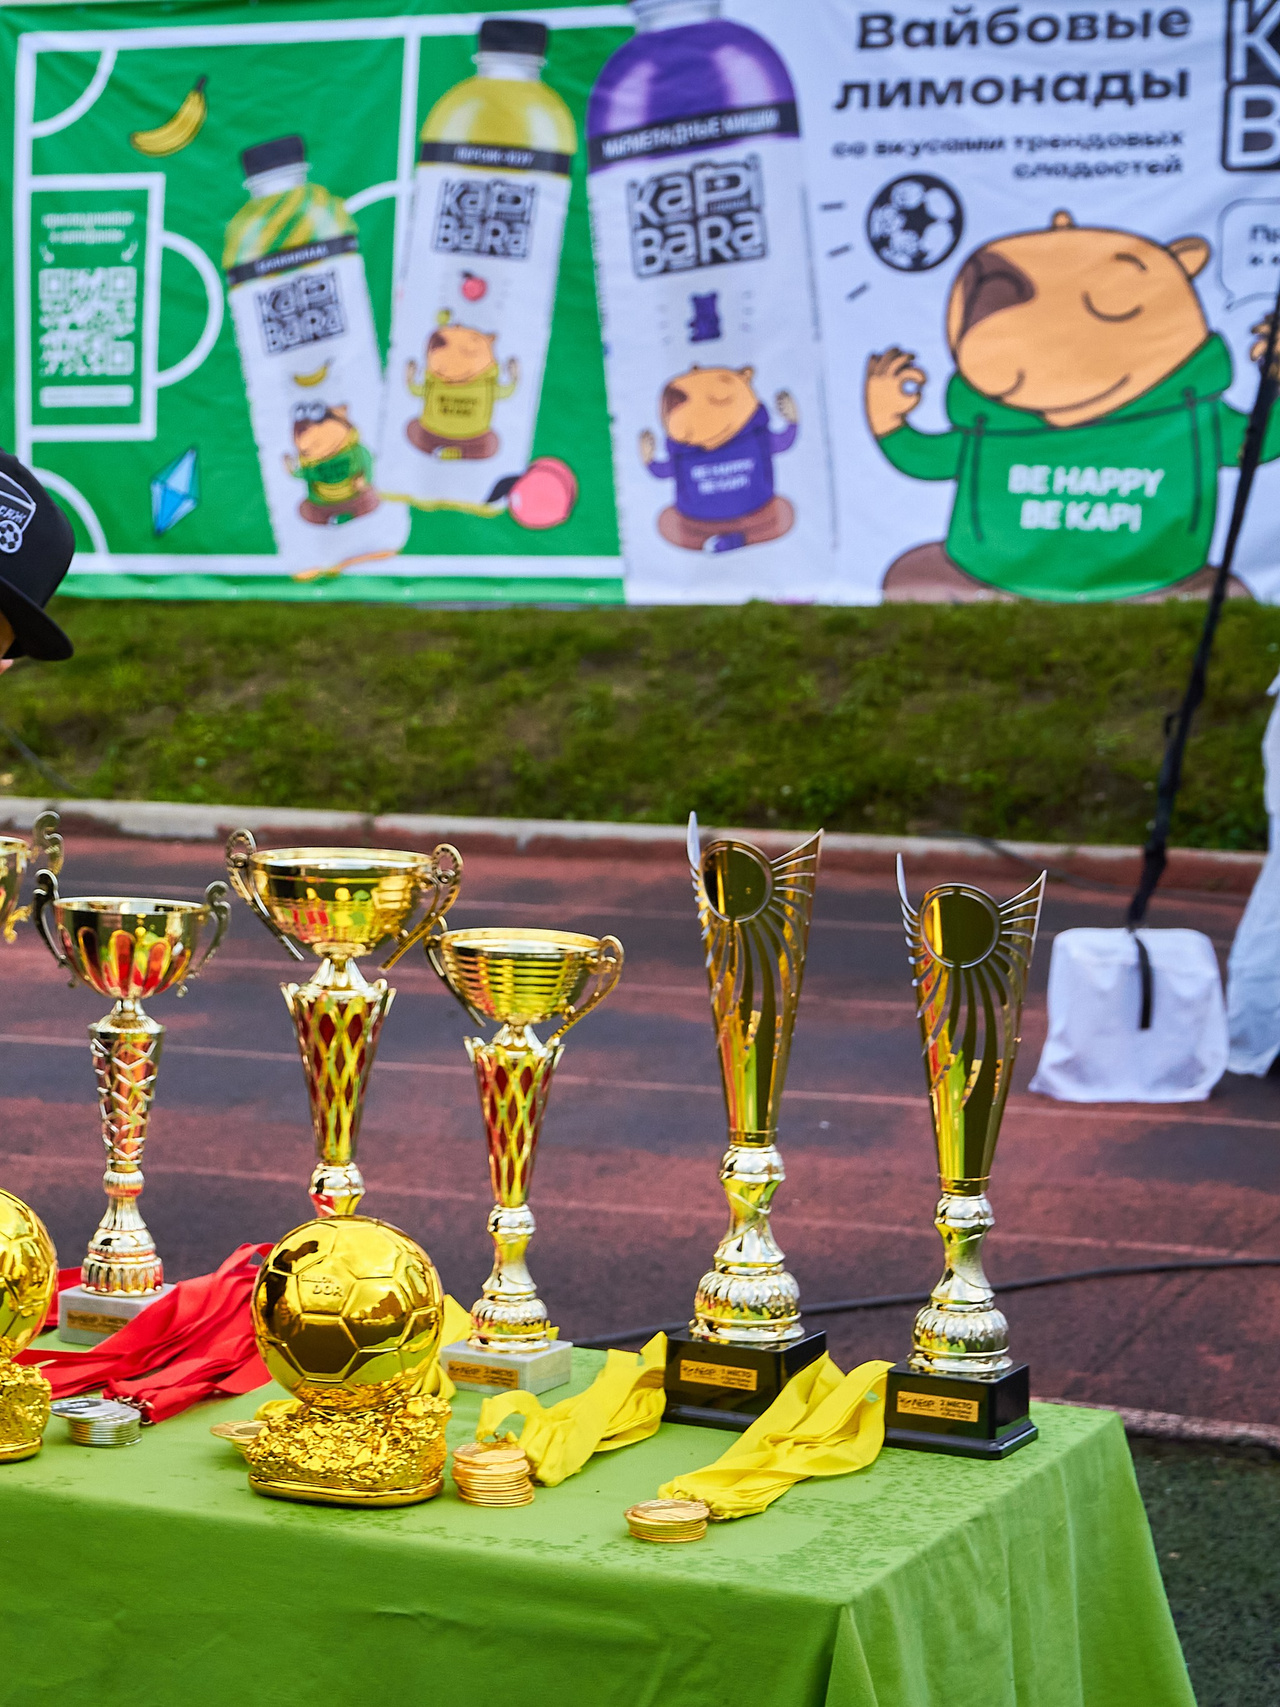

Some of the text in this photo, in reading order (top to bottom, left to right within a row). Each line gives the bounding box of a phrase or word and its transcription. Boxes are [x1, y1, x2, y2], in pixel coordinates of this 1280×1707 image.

[858, 6, 1191, 50] Вайбовые
[834, 69, 1189, 111] лимонады
[1007, 464, 1165, 498] BE HAPPY
[1020, 500, 1142, 533] BE KAPI
